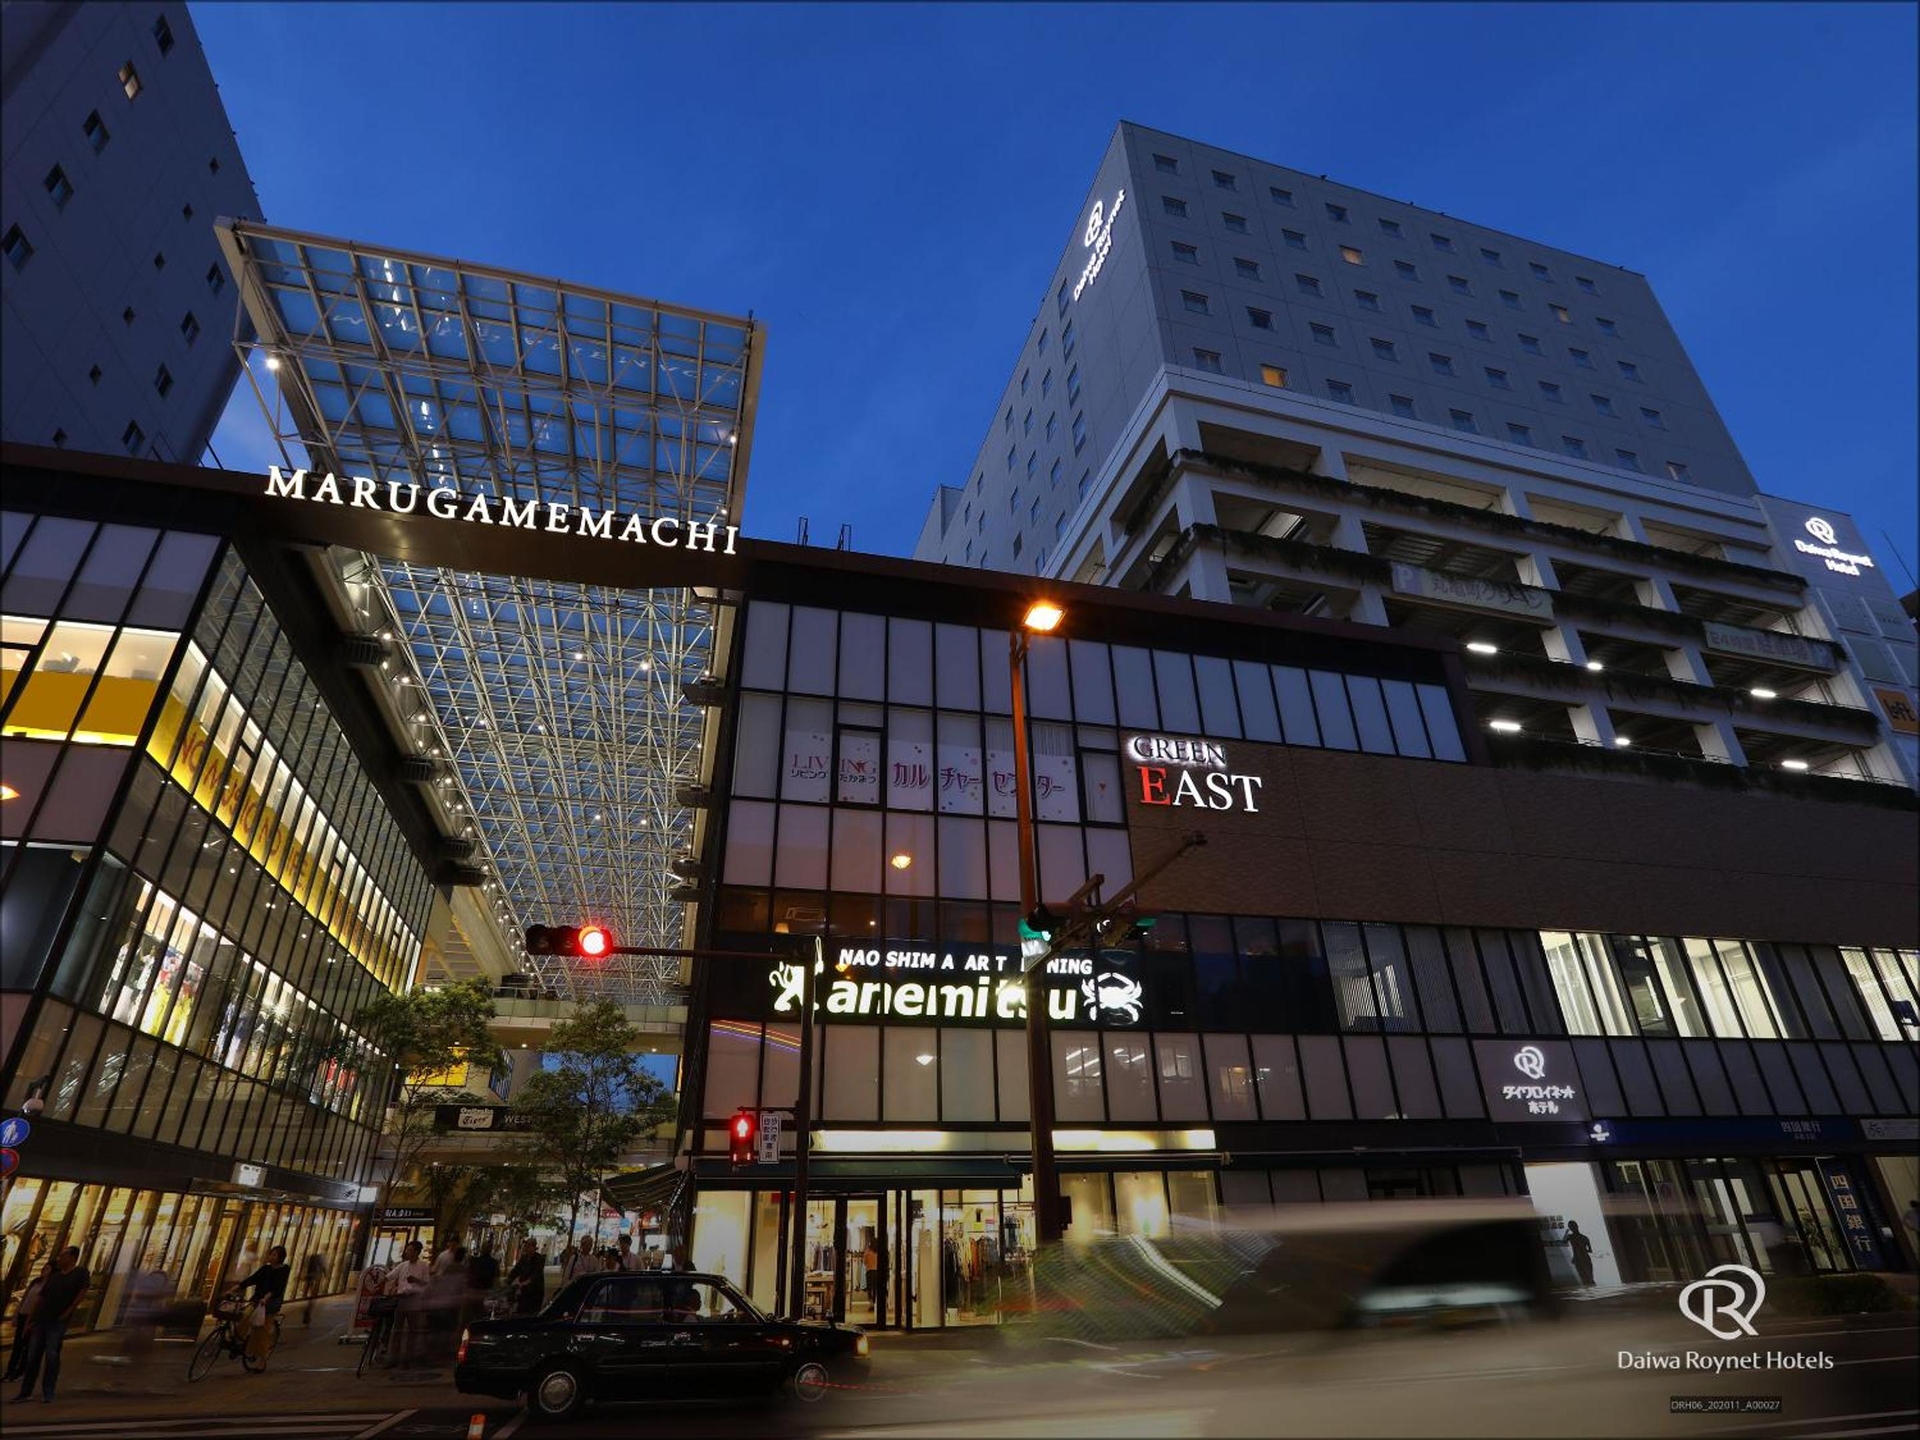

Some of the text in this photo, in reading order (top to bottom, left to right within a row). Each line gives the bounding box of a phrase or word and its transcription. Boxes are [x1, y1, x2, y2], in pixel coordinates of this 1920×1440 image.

[264, 465, 739, 555] MARUGAMEMACHI
[1133, 736, 1226, 765] GREEN
[1137, 766, 1262, 812] EAST
[1528, 1100, 1559, 1114] ホテル
[1829, 1174, 1872, 1252] 四国銀行
